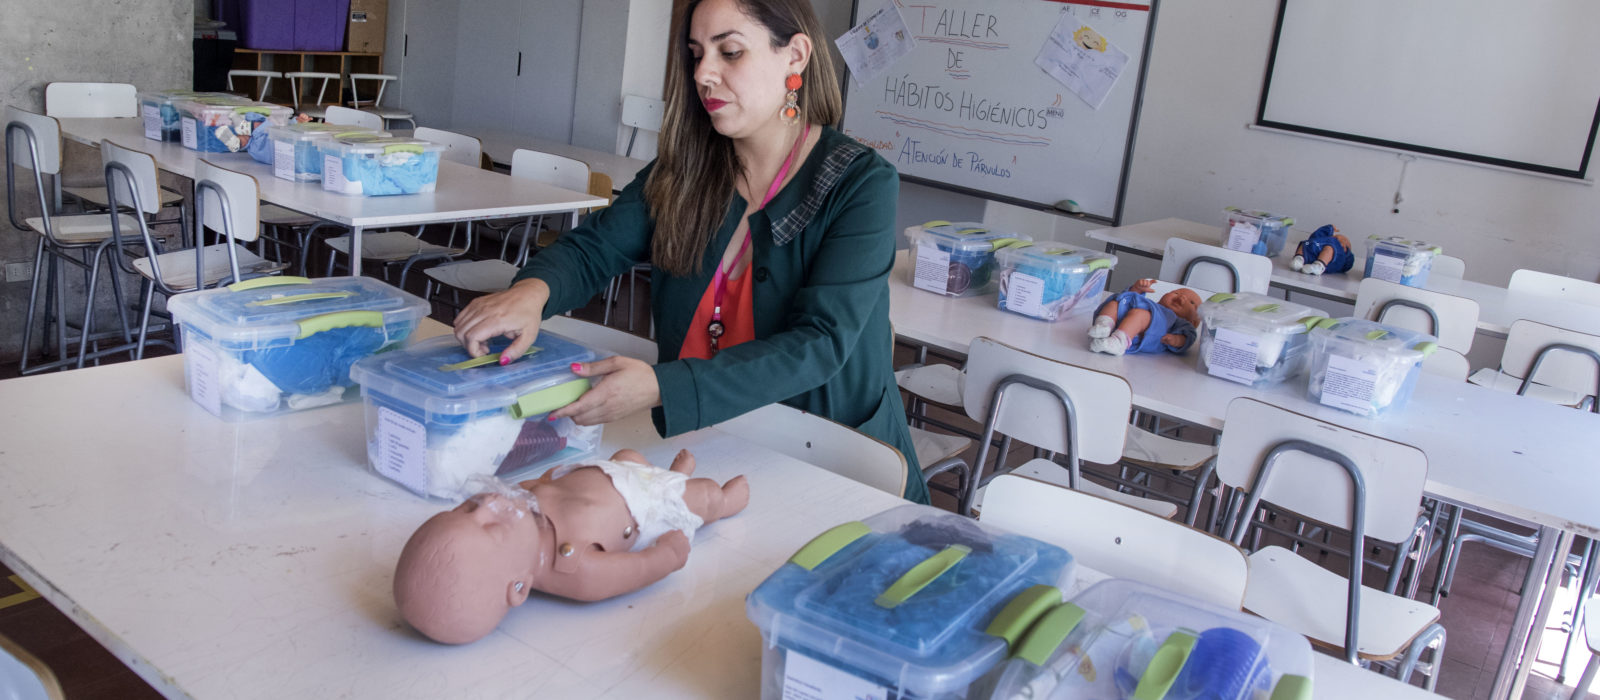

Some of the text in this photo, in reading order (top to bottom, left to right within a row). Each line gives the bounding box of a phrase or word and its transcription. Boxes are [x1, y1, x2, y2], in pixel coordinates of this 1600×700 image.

[909, 5, 999, 39] TALLER
[946, 47, 964, 70] DE
[884, 74, 1048, 130] HÁBITOS HIGIÉNICOS
[898, 136, 1012, 179] ATENCIÓN DE PÁRVULOS
